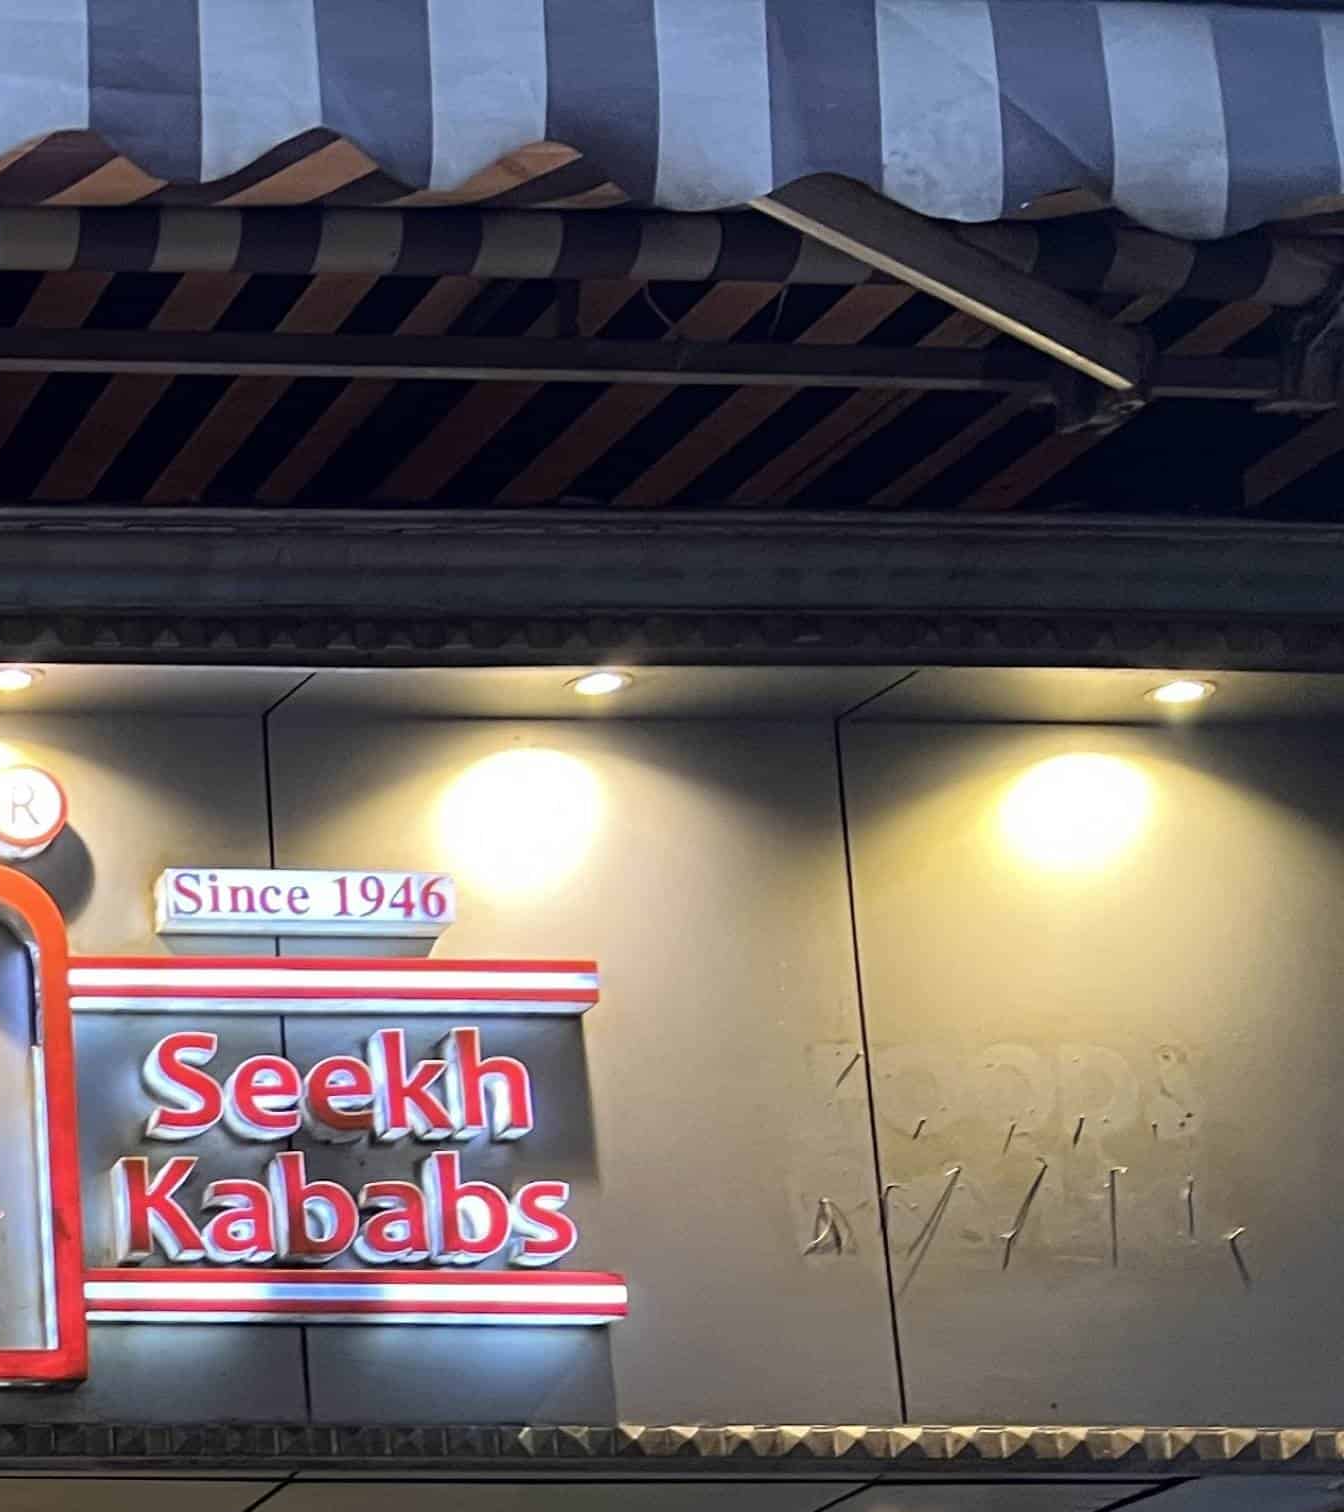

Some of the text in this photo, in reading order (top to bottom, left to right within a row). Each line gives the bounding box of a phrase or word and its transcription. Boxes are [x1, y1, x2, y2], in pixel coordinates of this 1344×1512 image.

[172, 871, 449, 920] Since 1946
[142, 1026, 534, 1142] Seekh
[113, 1150, 578, 1268] Kababs
